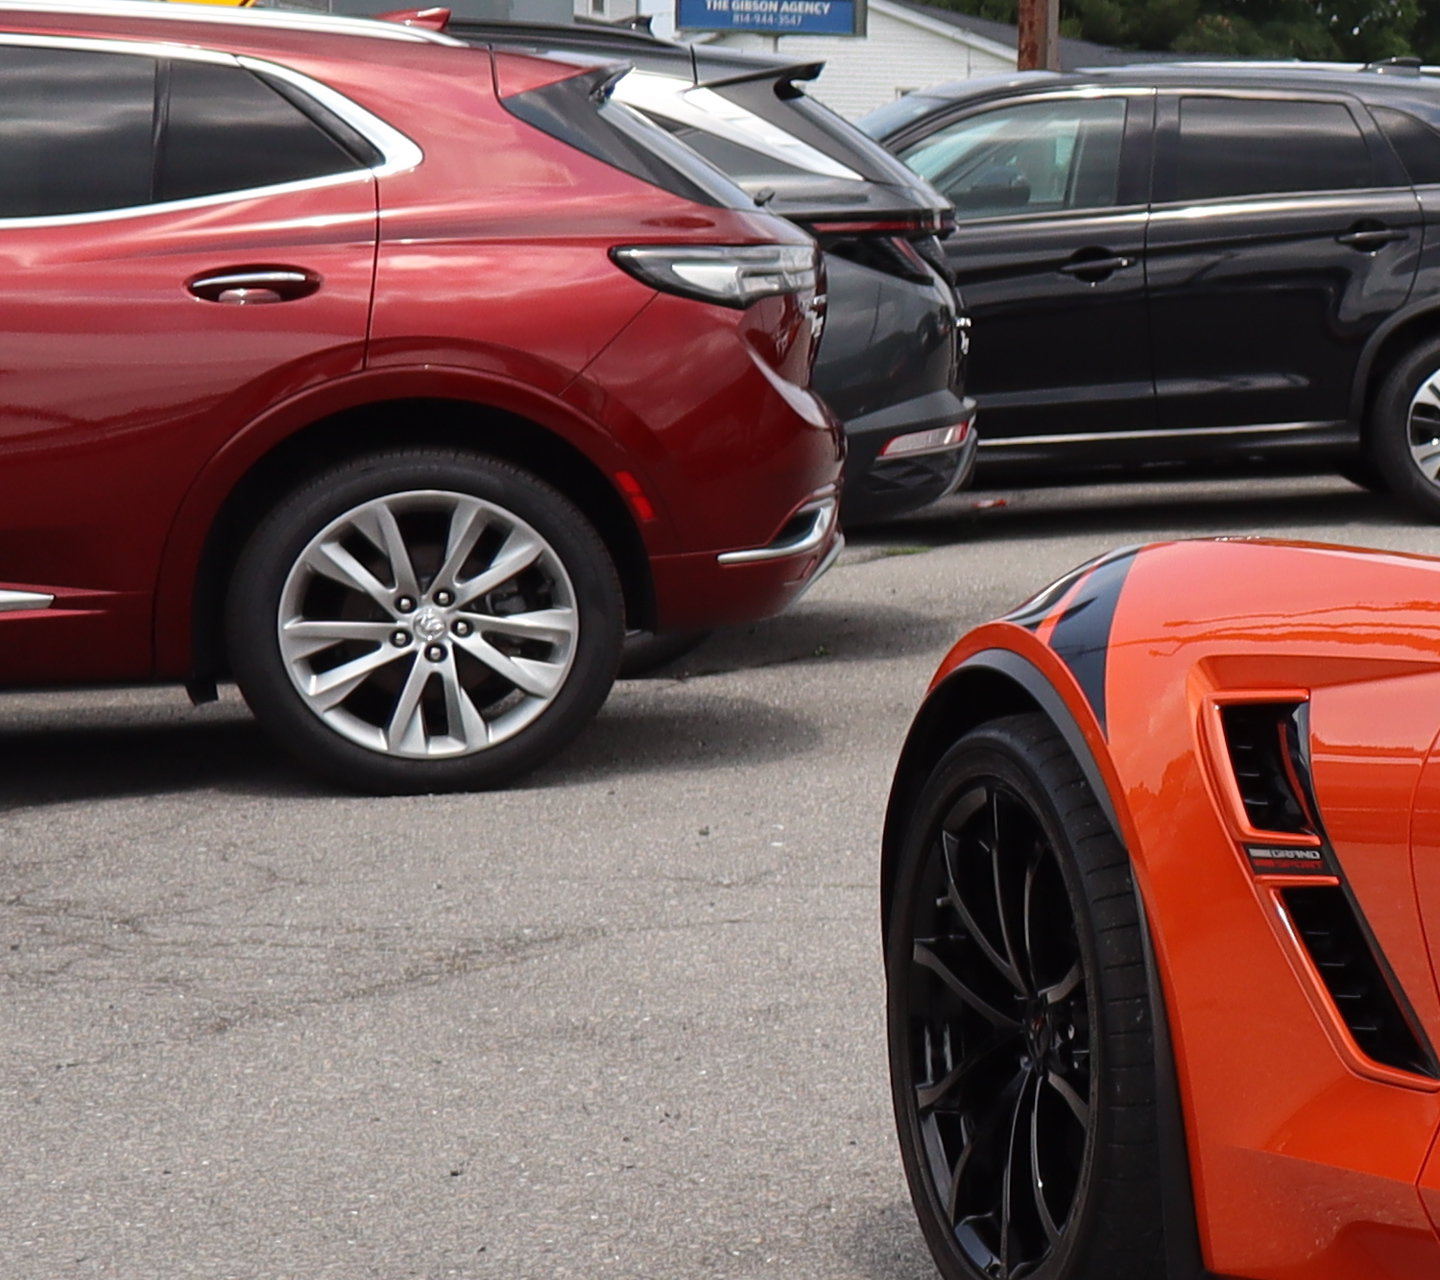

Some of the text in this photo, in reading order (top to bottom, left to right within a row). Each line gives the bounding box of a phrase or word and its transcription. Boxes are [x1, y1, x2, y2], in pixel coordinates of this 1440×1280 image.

[731, 0, 778, 12] GIBSON
[780, 0, 831, 15] AGENCY
[1271, 850, 1320, 859] GRAND
